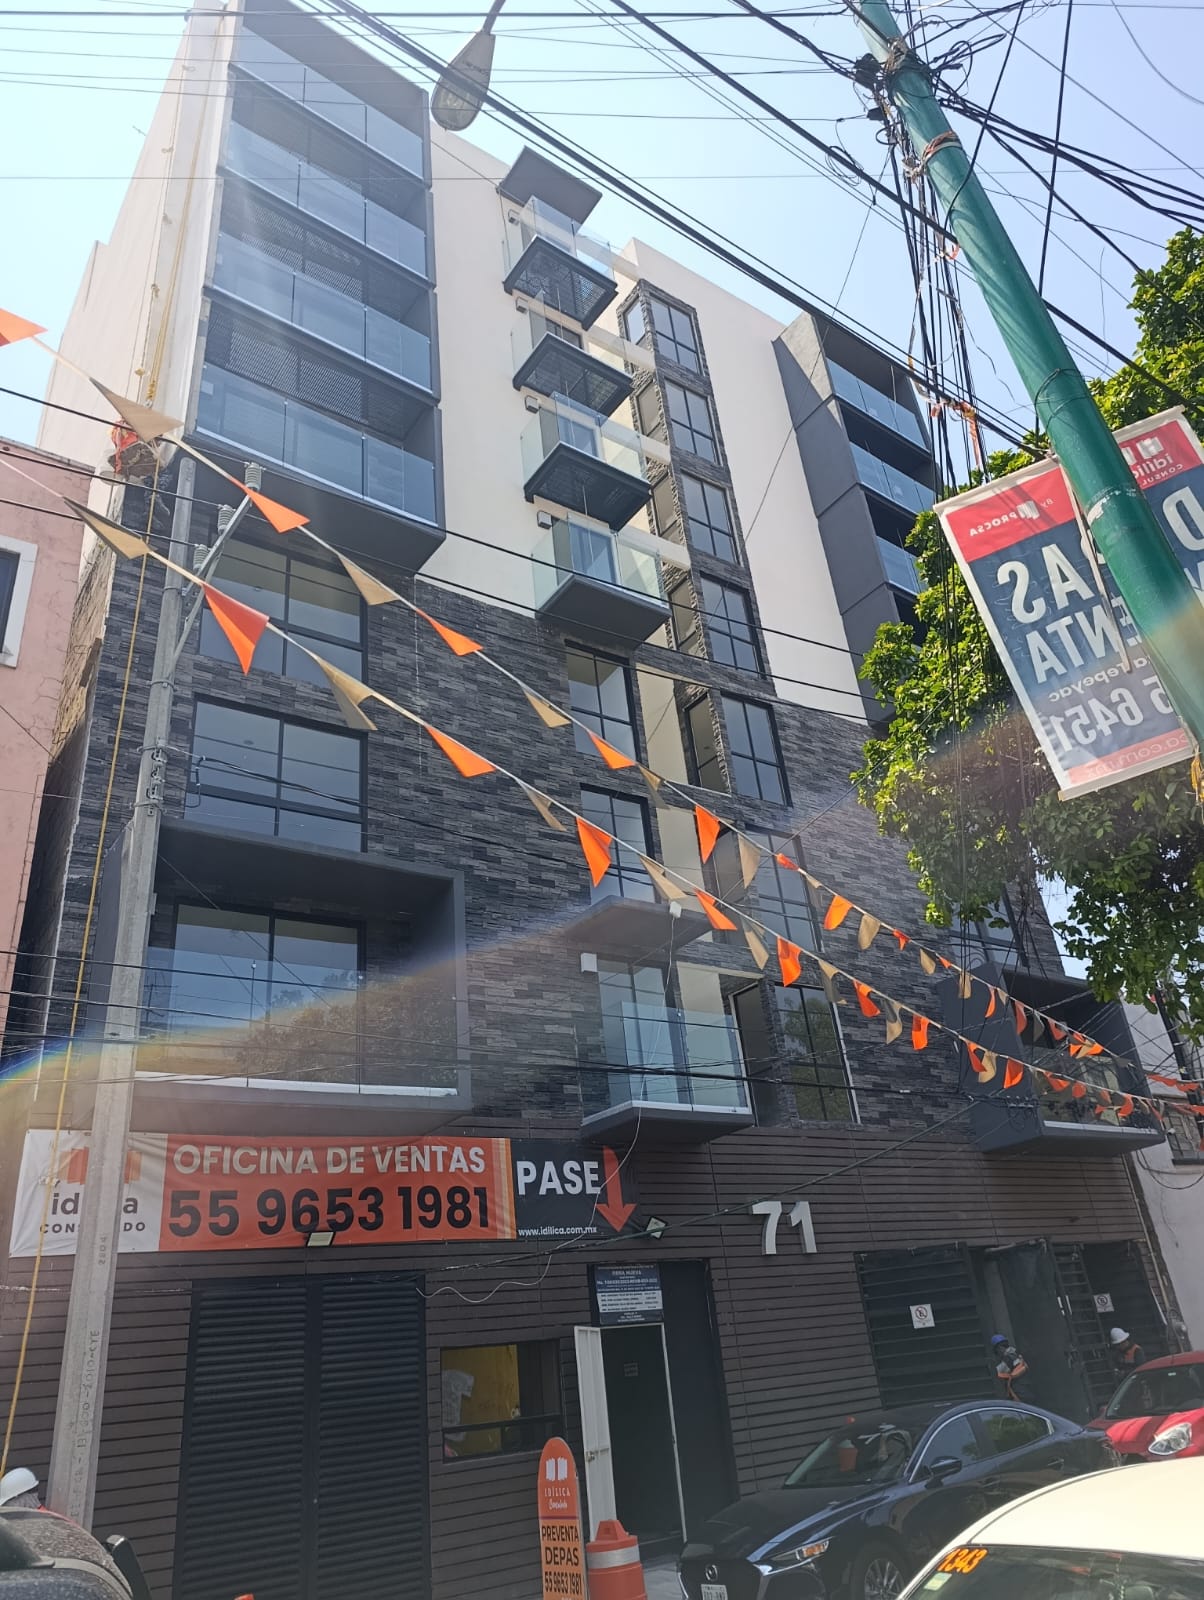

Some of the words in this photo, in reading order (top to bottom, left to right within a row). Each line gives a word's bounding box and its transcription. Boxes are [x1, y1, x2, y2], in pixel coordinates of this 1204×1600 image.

[172, 1144, 318, 1175] OFICINA
[326, 1145, 365, 1175] DE
[371, 1145, 486, 1174] VENTAS
[516, 1160, 601, 1196] PASE
[168, 1189, 240, 1237] 55
[256, 1186, 385, 1235] 9653
[397, 1185, 489, 1231] 1981
[752, 1200, 818, 1255] 71
[541, 1525, 579, 1543] PREVENTA
[544, 1546, 580, 1567] DEPAS
[937, 1547, 989, 1575] 1343
[544, 1570, 553, 1593] 55
